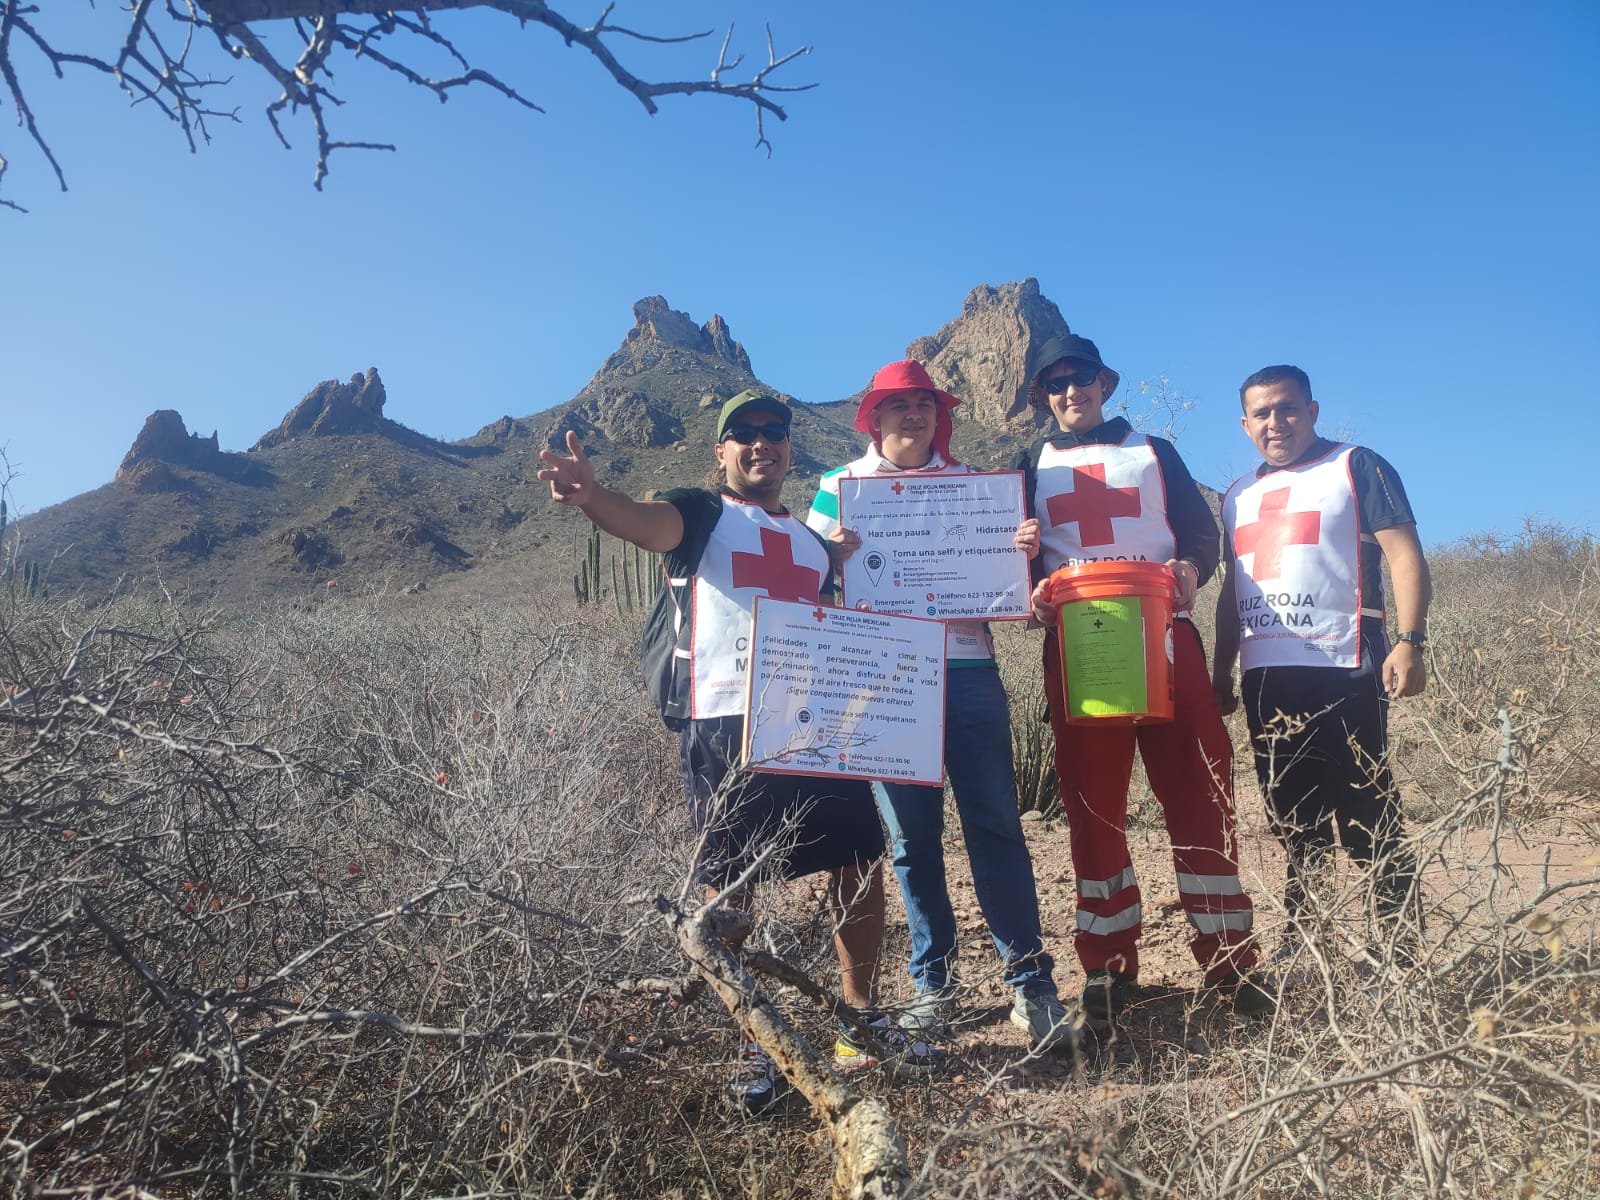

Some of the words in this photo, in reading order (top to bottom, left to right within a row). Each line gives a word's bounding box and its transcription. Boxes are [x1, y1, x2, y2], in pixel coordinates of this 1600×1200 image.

[868, 530, 884, 538] Haz
[904, 529, 930, 538] pausa
[976, 526, 1017, 534] Hidrátate
[892, 550, 916, 558] Toma
[938, 548, 955, 556] selfi
[957, 549, 963, 557] y
[965, 546, 1017, 556] etiquétanos
[1240, 595, 1262, 613] RUZ
[1266, 592, 1315, 608] ROJA
[938, 606, 974, 615] WhatsApp
[976, 606, 1022, 614] 622138-69-70
[863, 618, 890, 627] MEXICANA
[1240, 612, 1314, 632] EXICANA
[762, 636, 808, 647] ¡Felicidades
[841, 645, 872, 655] alcanzar
[898, 652, 917, 660] cima!
[826, 656, 880, 668] perseverancia,
[896, 663, 918, 672] fuerza
[761, 659, 820, 673] deteminación,
[828, 667, 849, 676] ahora
[857, 671, 886, 680] disfruta
[892, 674, 900, 682] de
[826, 679, 840, 687] aire
[843, 680, 866, 689] fresco
[786, 686, 808, 696] ¡Sigue
[810, 688, 859, 700] conquistando
[886, 698, 914, 706] alturas!
[855, 711, 868, 719] selfi
[876, 714, 916, 723] etiquétanos
[848, 765, 876, 774] WhatsApp
